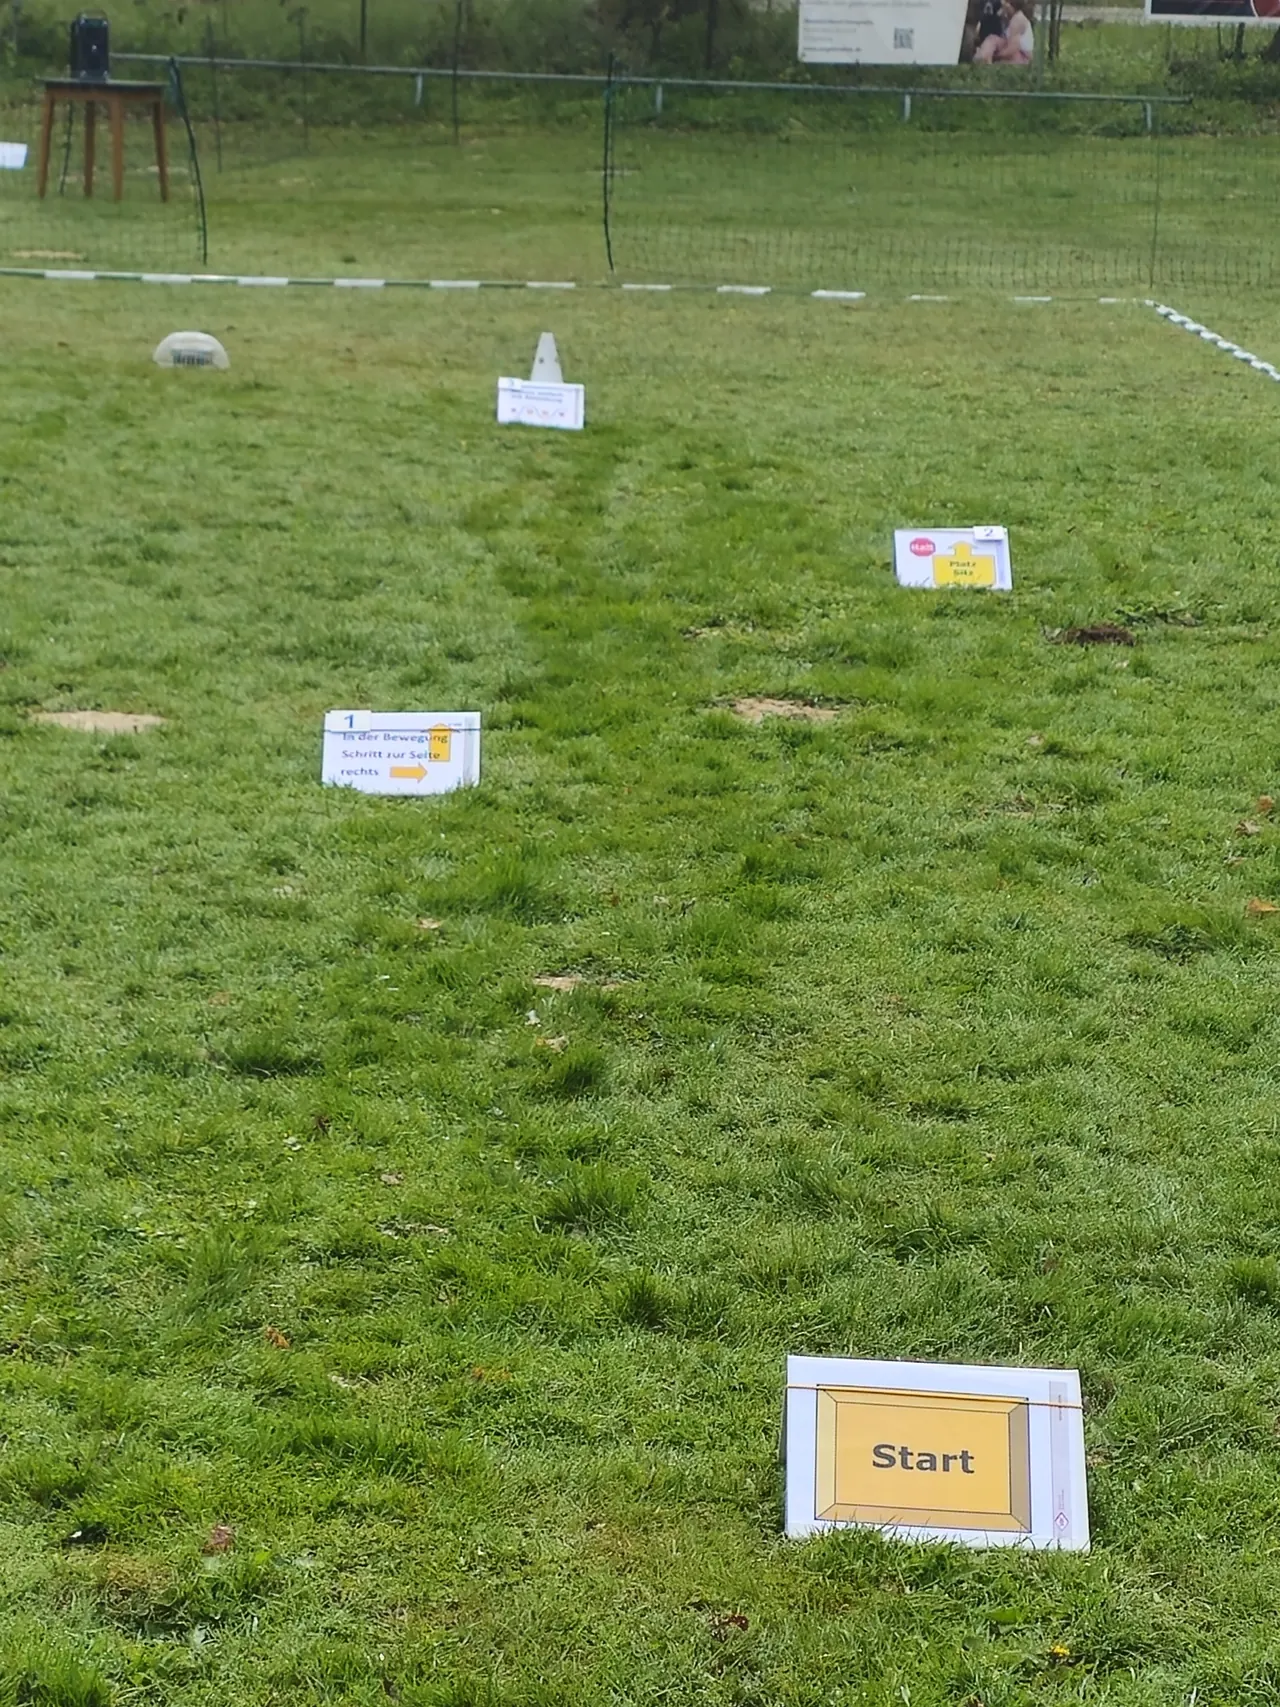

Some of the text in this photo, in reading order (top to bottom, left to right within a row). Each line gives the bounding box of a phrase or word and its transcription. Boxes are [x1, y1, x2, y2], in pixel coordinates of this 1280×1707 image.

[984, 528, 993, 537] 2
[344, 713, 354, 729] 1
[358, 732, 378, 741] der
[383, 732, 448, 744] Bewegung
[341, 750, 441, 760] Schritt zur Seite
[340, 767, 379, 777] rechts
[872, 1443, 975, 1474] Start
